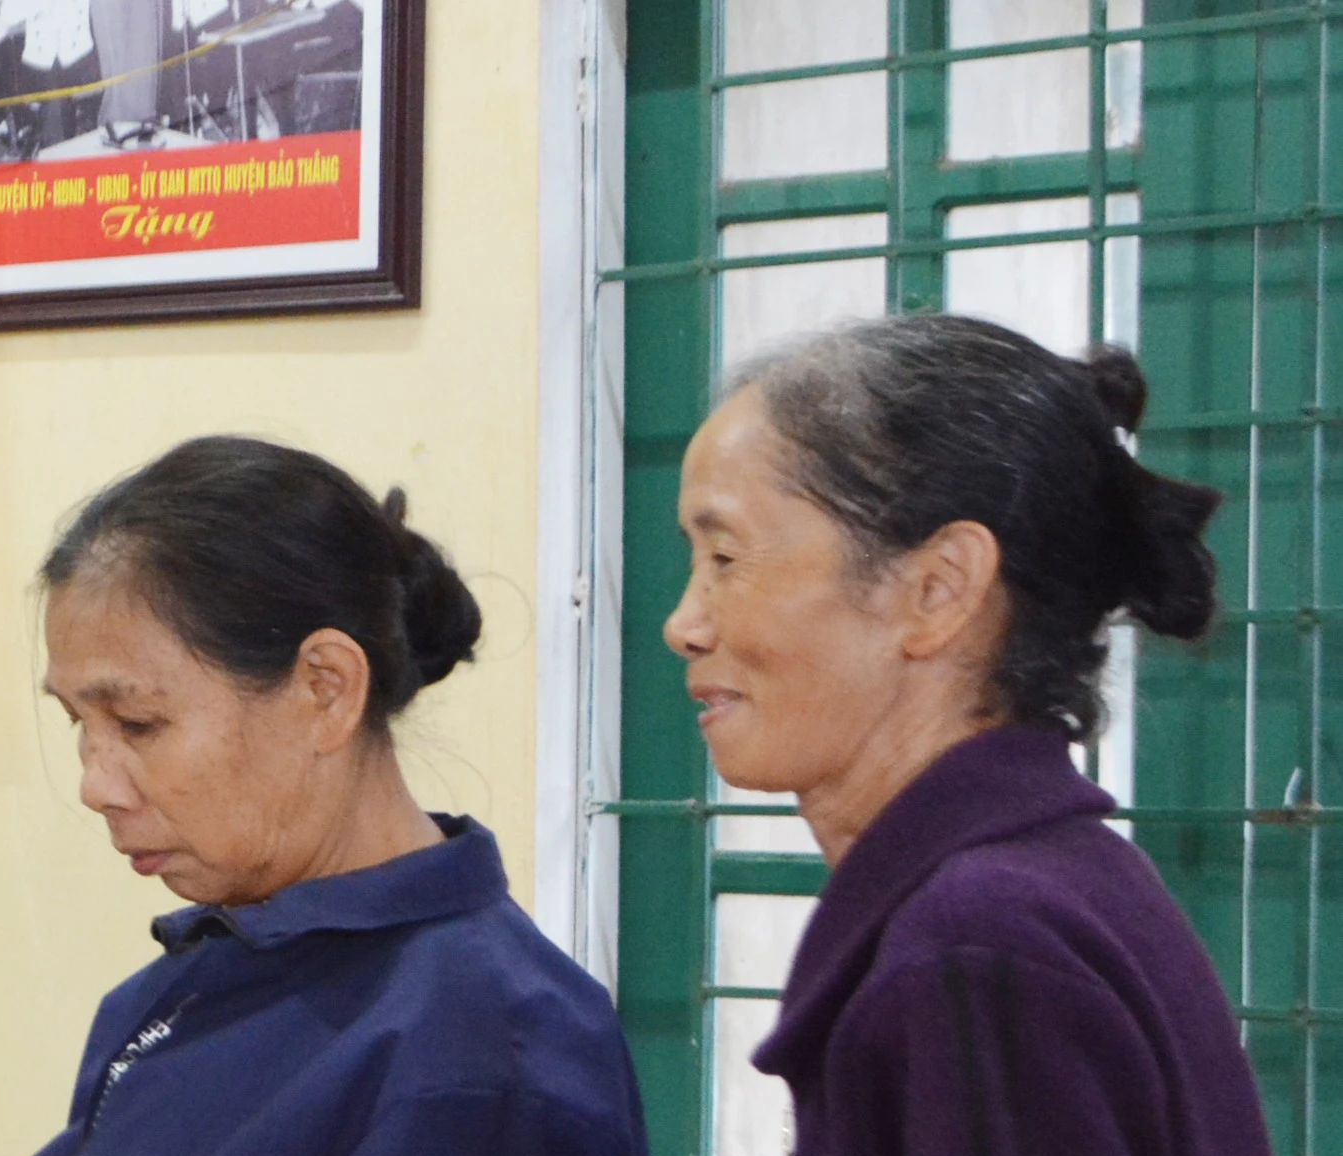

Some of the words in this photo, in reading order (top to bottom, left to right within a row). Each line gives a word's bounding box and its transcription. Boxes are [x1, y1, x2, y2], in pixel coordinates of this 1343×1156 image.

[31, 171, 46, 211] ỦY
[97, 173, 130, 204] UBND
[141, 160, 157, 199] ỦY
[159, 168, 186, 198] BAN
[188, 165, 221, 197] MTTQ
[224, 156, 265, 197] HUYỆN
[268, 148, 294, 190] BẢO
[101, 204, 214, 246] Tặng
